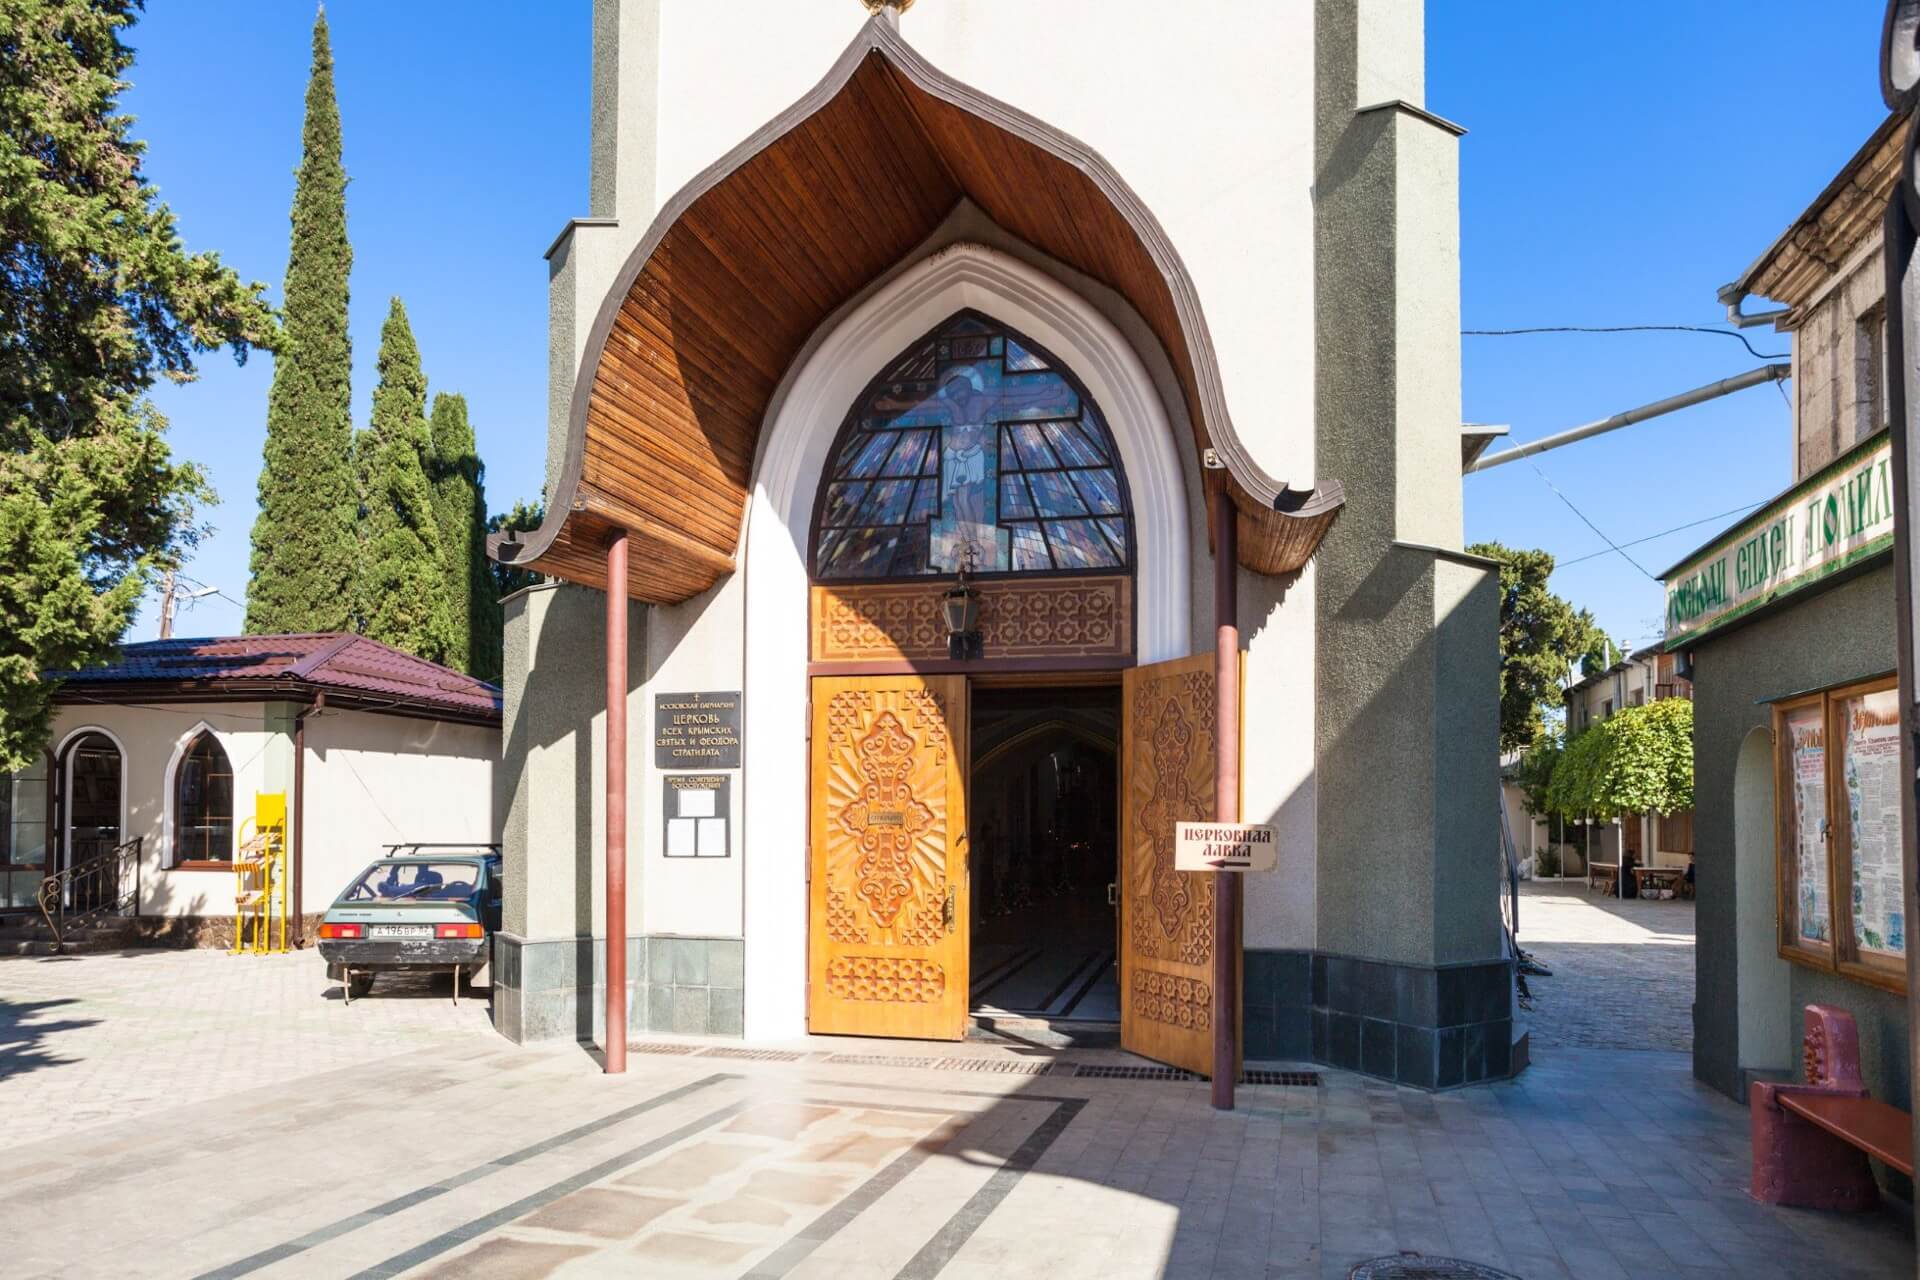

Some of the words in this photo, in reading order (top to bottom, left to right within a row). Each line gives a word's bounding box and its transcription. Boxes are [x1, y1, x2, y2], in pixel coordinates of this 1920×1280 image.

[1736, 513, 1795, 593] СПАСИ
[673, 713, 720, 725] ЦЕРКОВЬ
[662, 728, 682, 736] ВСЕХ
[688, 726, 732, 736] КРЫМСКИХ
[656, 738, 686, 746] СВЯТЫХ
[699, 737, 739, 746] ФЕОДОРА
[1184, 828, 1271, 843] ЦЕРКОВНАЯ
[1202, 844, 1251, 857] ЛАВКА
